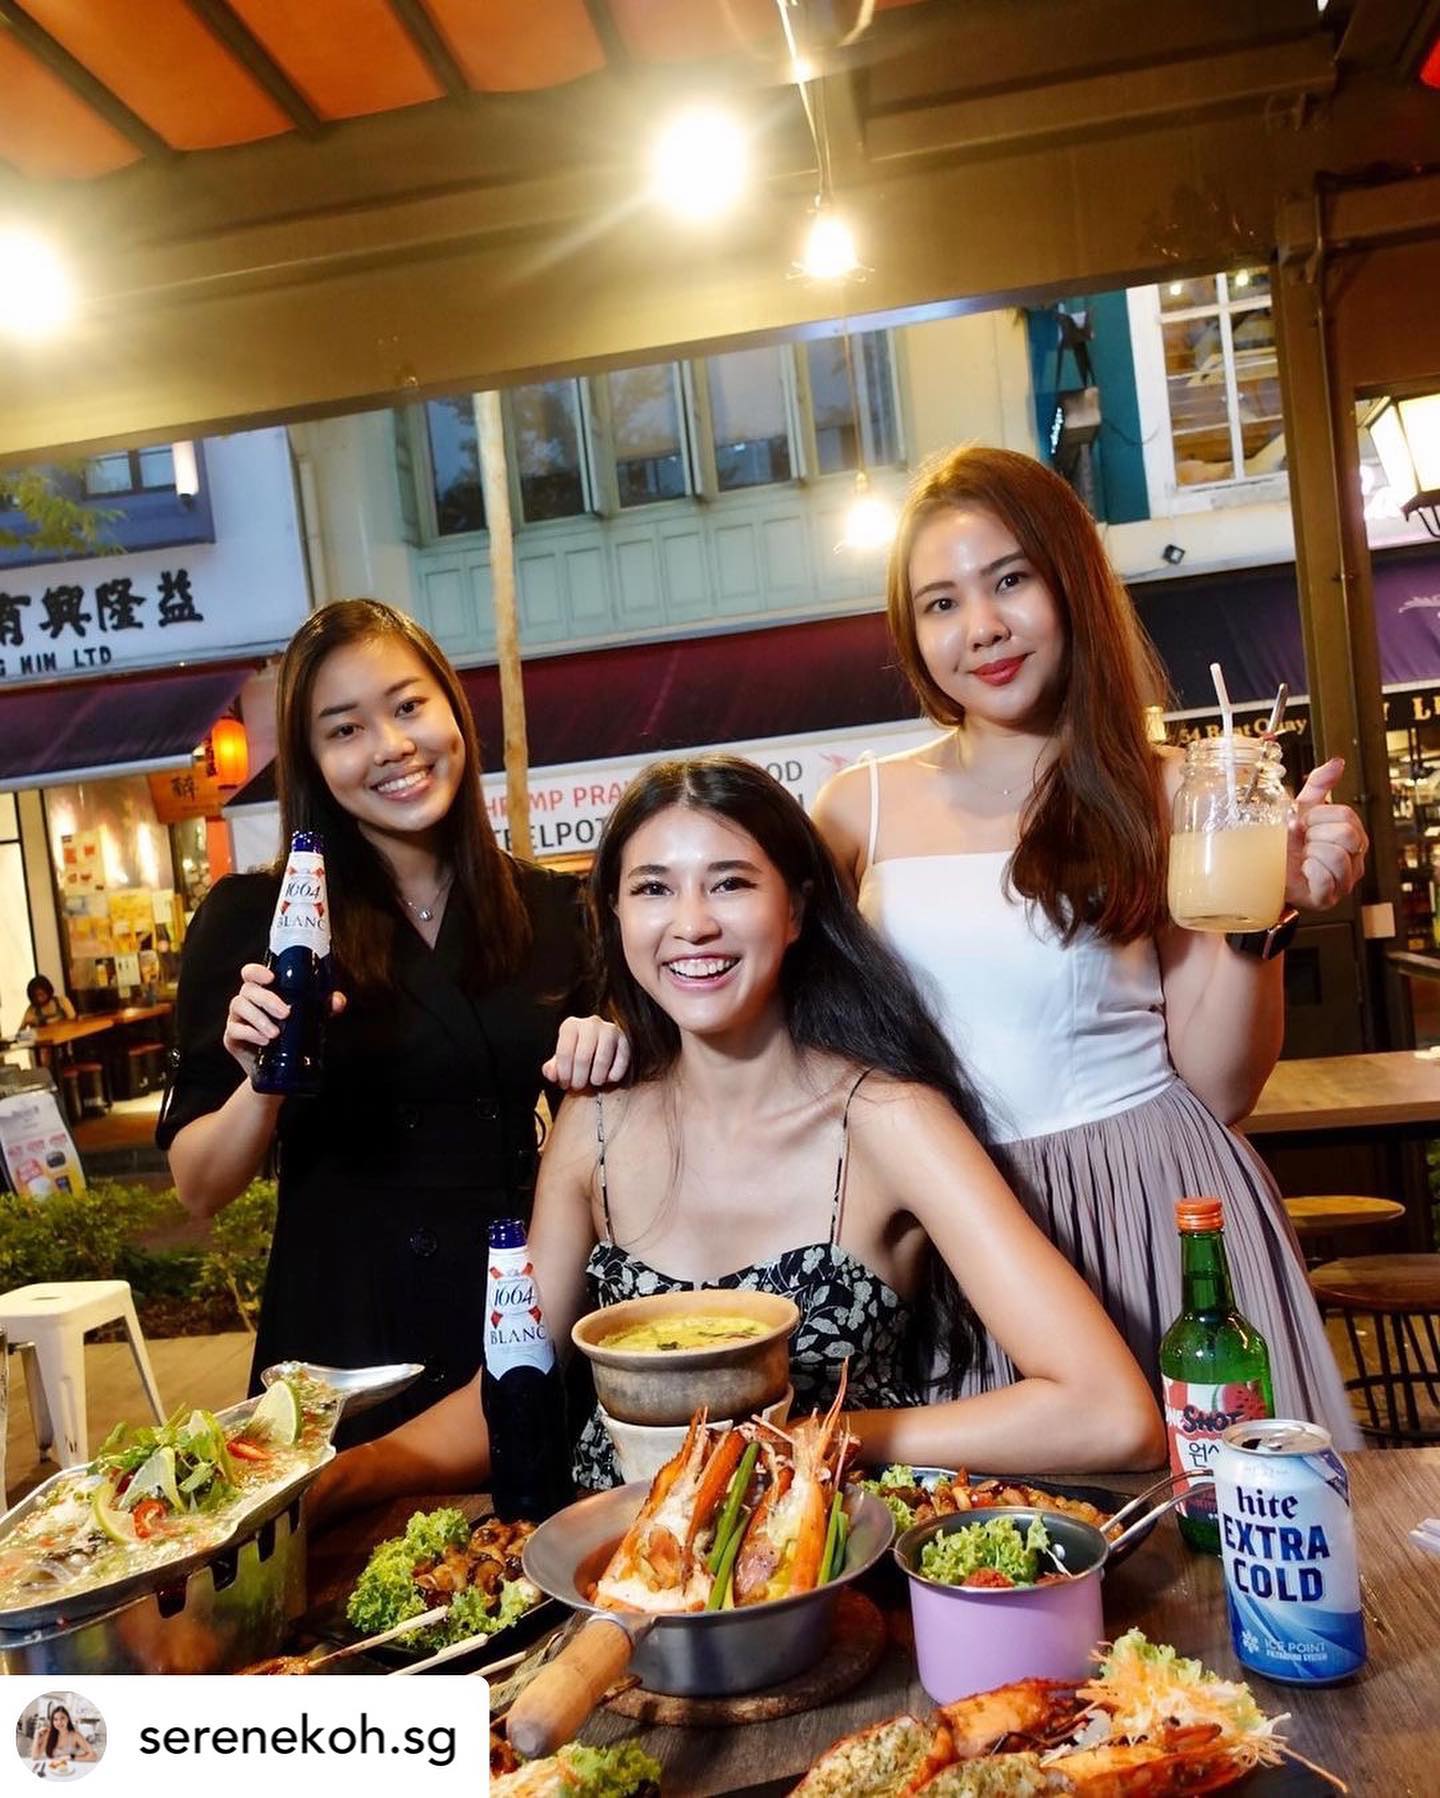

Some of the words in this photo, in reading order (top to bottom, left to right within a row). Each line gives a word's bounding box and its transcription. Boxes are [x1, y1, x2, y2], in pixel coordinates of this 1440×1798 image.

[73, 645, 112, 669] LTD
[285, 881, 321, 899] 1664
[277, 916, 327, 931] BLANC
[494, 1284, 534, 1306] 1664
[490, 1325, 546, 1345] BLANC
[1236, 1485, 1299, 1520] hite
[1223, 1513, 1330, 1561] EXTRA
[1233, 1557, 1324, 1602] COLD
[1287, 1641, 1326, 1654] POINT
